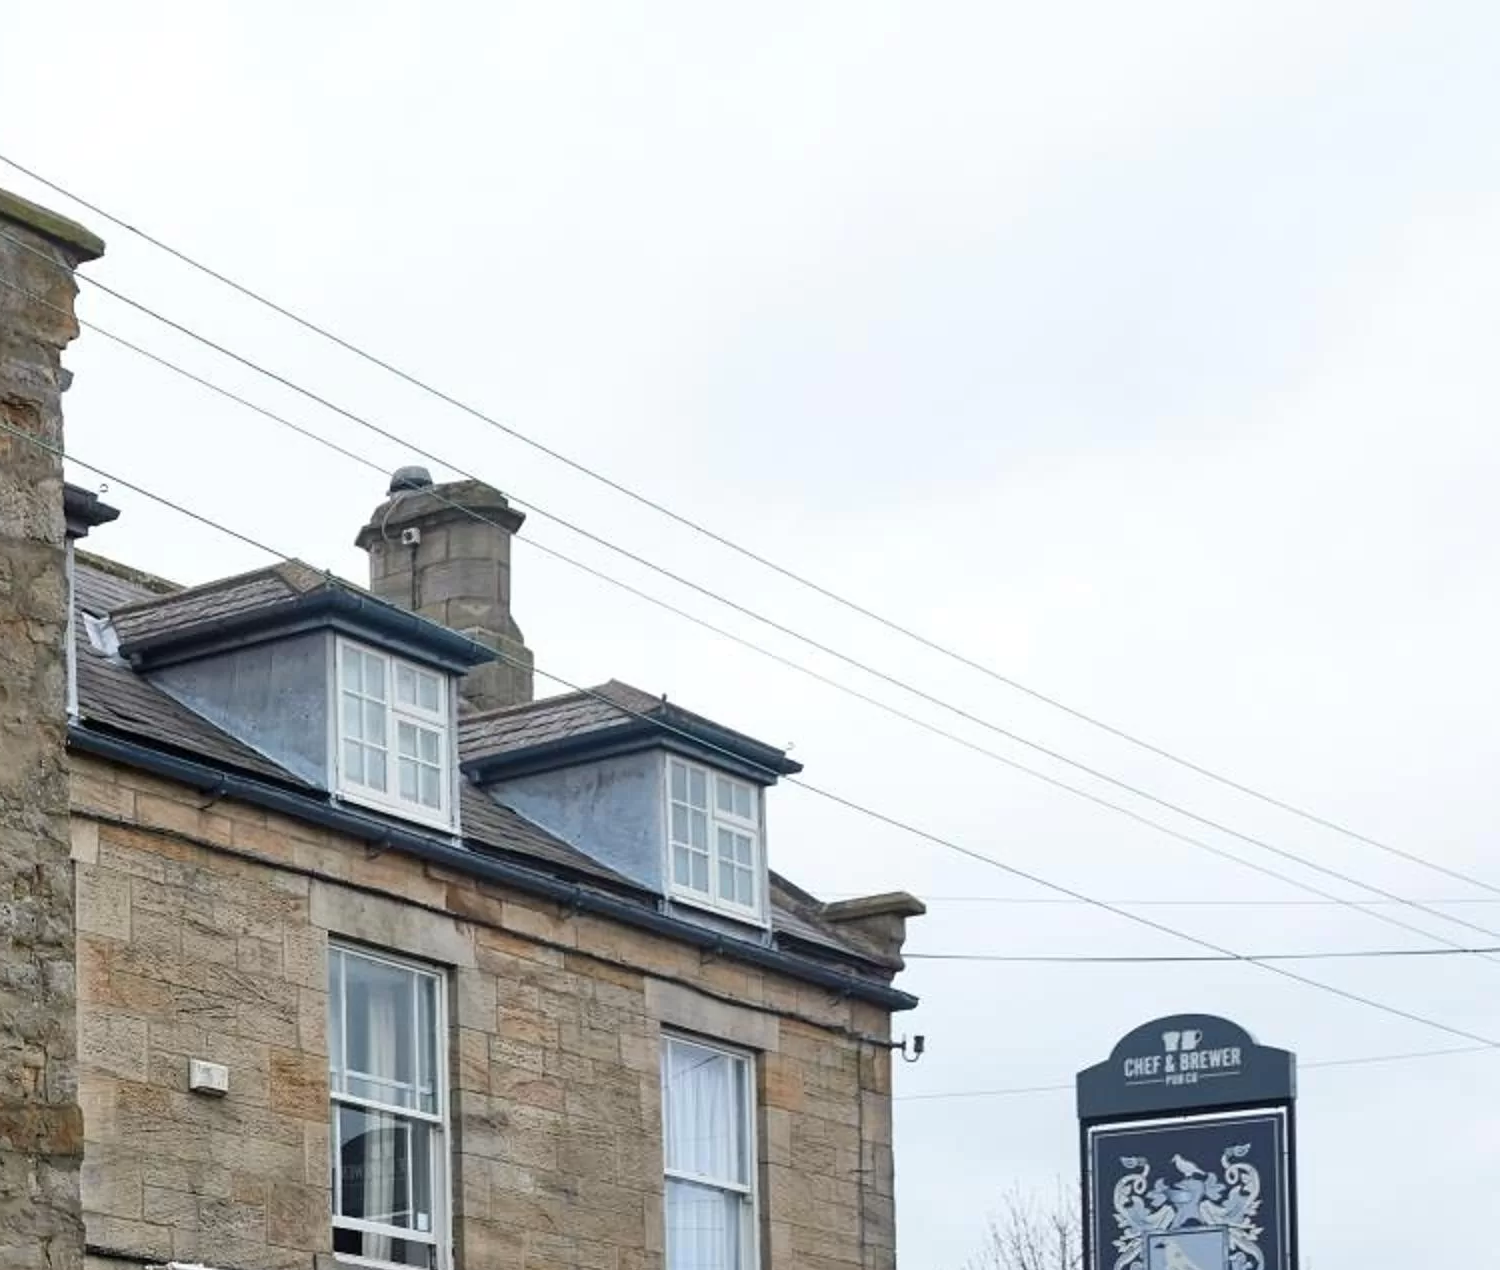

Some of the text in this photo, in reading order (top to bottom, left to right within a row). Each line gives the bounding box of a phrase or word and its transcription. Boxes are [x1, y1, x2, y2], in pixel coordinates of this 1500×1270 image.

[1123, 1047, 1241, 1077] CHEF & BREWER
